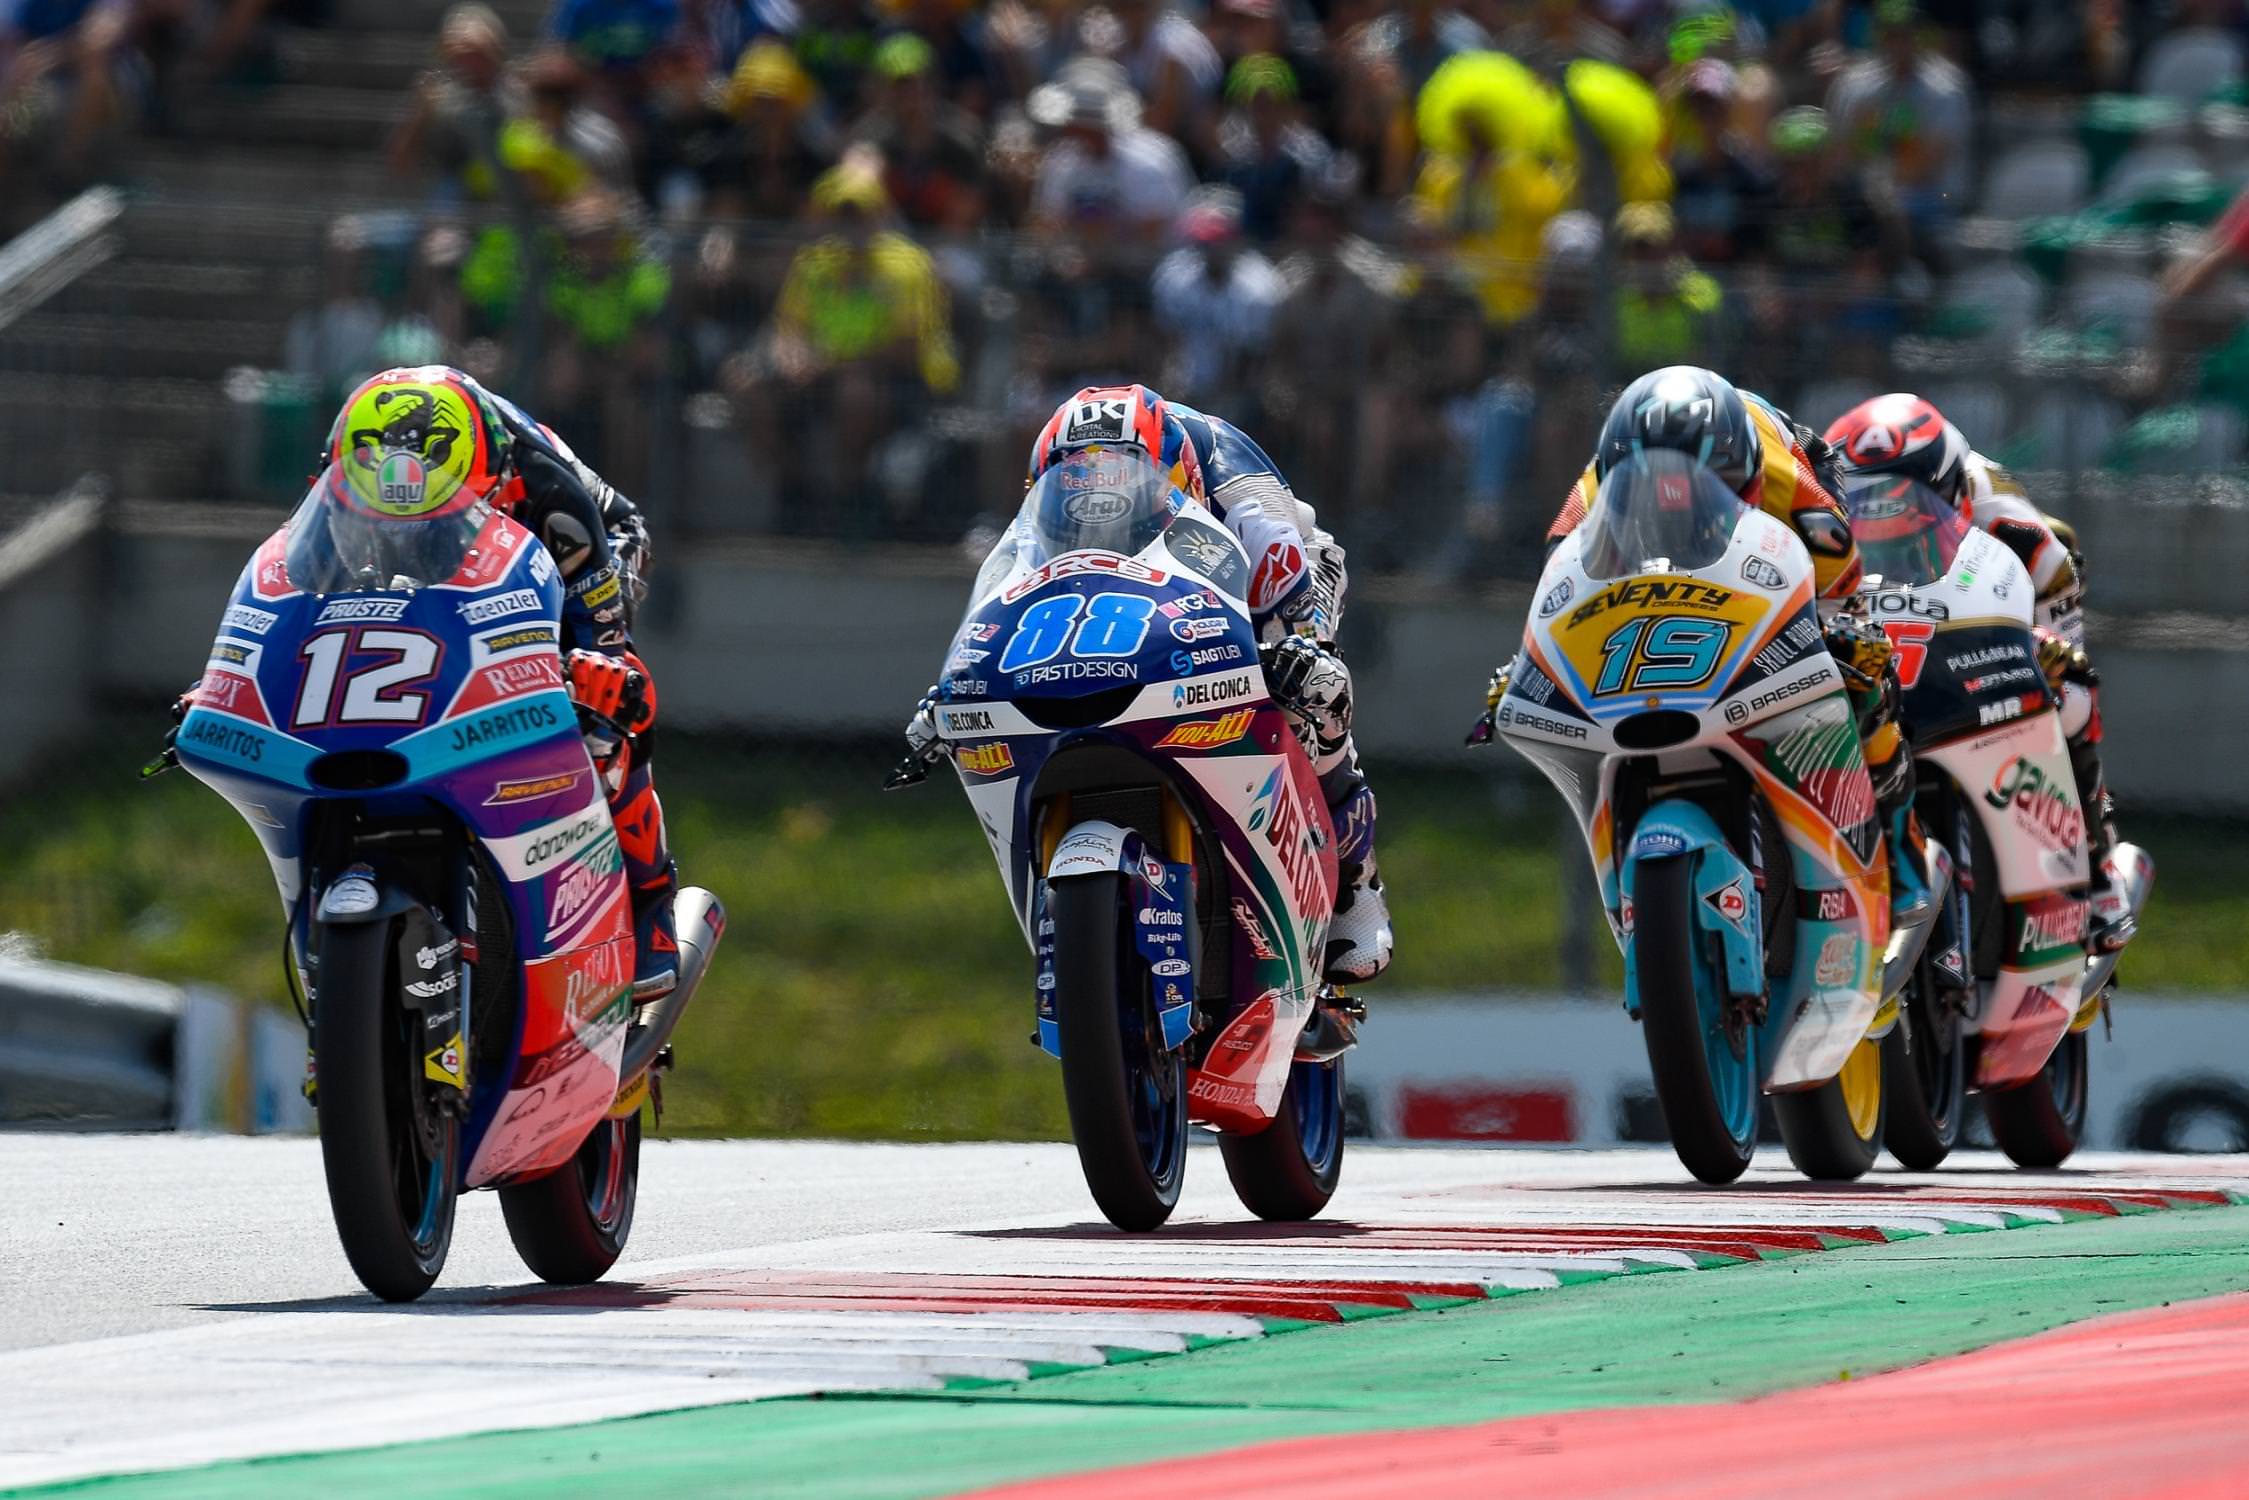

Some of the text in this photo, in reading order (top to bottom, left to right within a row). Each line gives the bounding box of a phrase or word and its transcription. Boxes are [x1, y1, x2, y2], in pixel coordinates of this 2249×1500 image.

[1061, 468, 1127, 489] Red Bull
[1072, 495, 1123, 516] Arai
[317, 598, 406, 621] PRÜSTEL
[1566, 582, 1732, 630] SEVENTY
[998, 592, 1157, 674] 88
[1191, 644, 1242, 666] SAGTUBI
[1593, 615, 1734, 698] 19
[294, 630, 439, 727] 12
[485, 658, 562, 696] REDOX
[1751, 669, 1834, 713] BRESSER
[452, 703, 557, 752] JARRITOS
[1167, 708, 1254, 744] YOU-ALL
[1514, 712, 1588, 741] BRESSER
[1055, 855, 1106, 870] HONDA
[1148, 910, 1184, 926] Kratos
